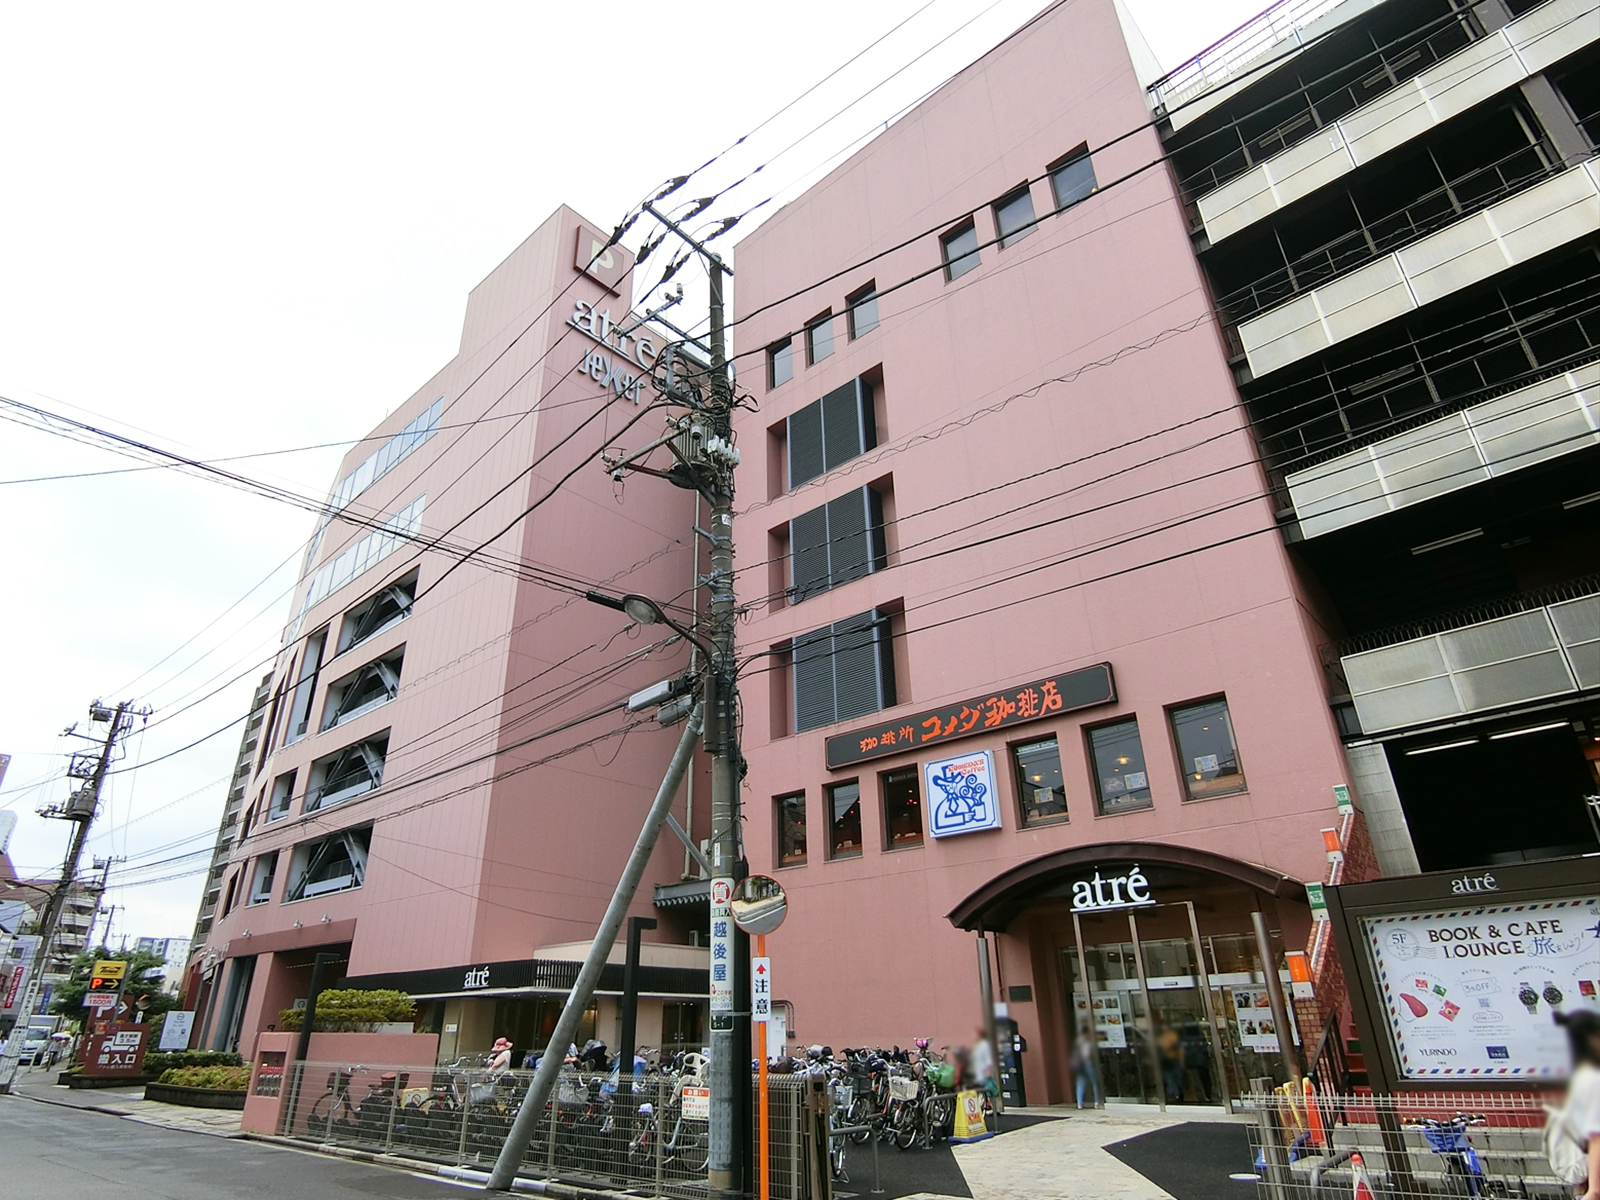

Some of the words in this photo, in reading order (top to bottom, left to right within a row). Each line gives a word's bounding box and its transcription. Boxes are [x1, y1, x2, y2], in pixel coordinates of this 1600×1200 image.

[589, 239, 615, 275] P
[571, 299, 658, 374] atré
[859, 725, 915, 753] 珈琲所
[921, 680, 1063, 742] コメダ珈琲店
[1072, 867, 1151, 909] atré
[1451, 872, 1497, 894] atré
[1391, 933, 1407, 945] 5F
[1426, 925, 1482, 943] BOOK
[1488, 924, 1502, 939] &
[1508, 919, 1563, 937] CAFE
[713, 921, 727, 982] 越後屋
[1442, 940, 1525, 959] LOUNGE
[91, 978, 103, 989] P
[464, 965, 490, 988] atré
[755, 978, 769, 1015] 注意
[1419, 1048, 1457, 1057] YURINDO
